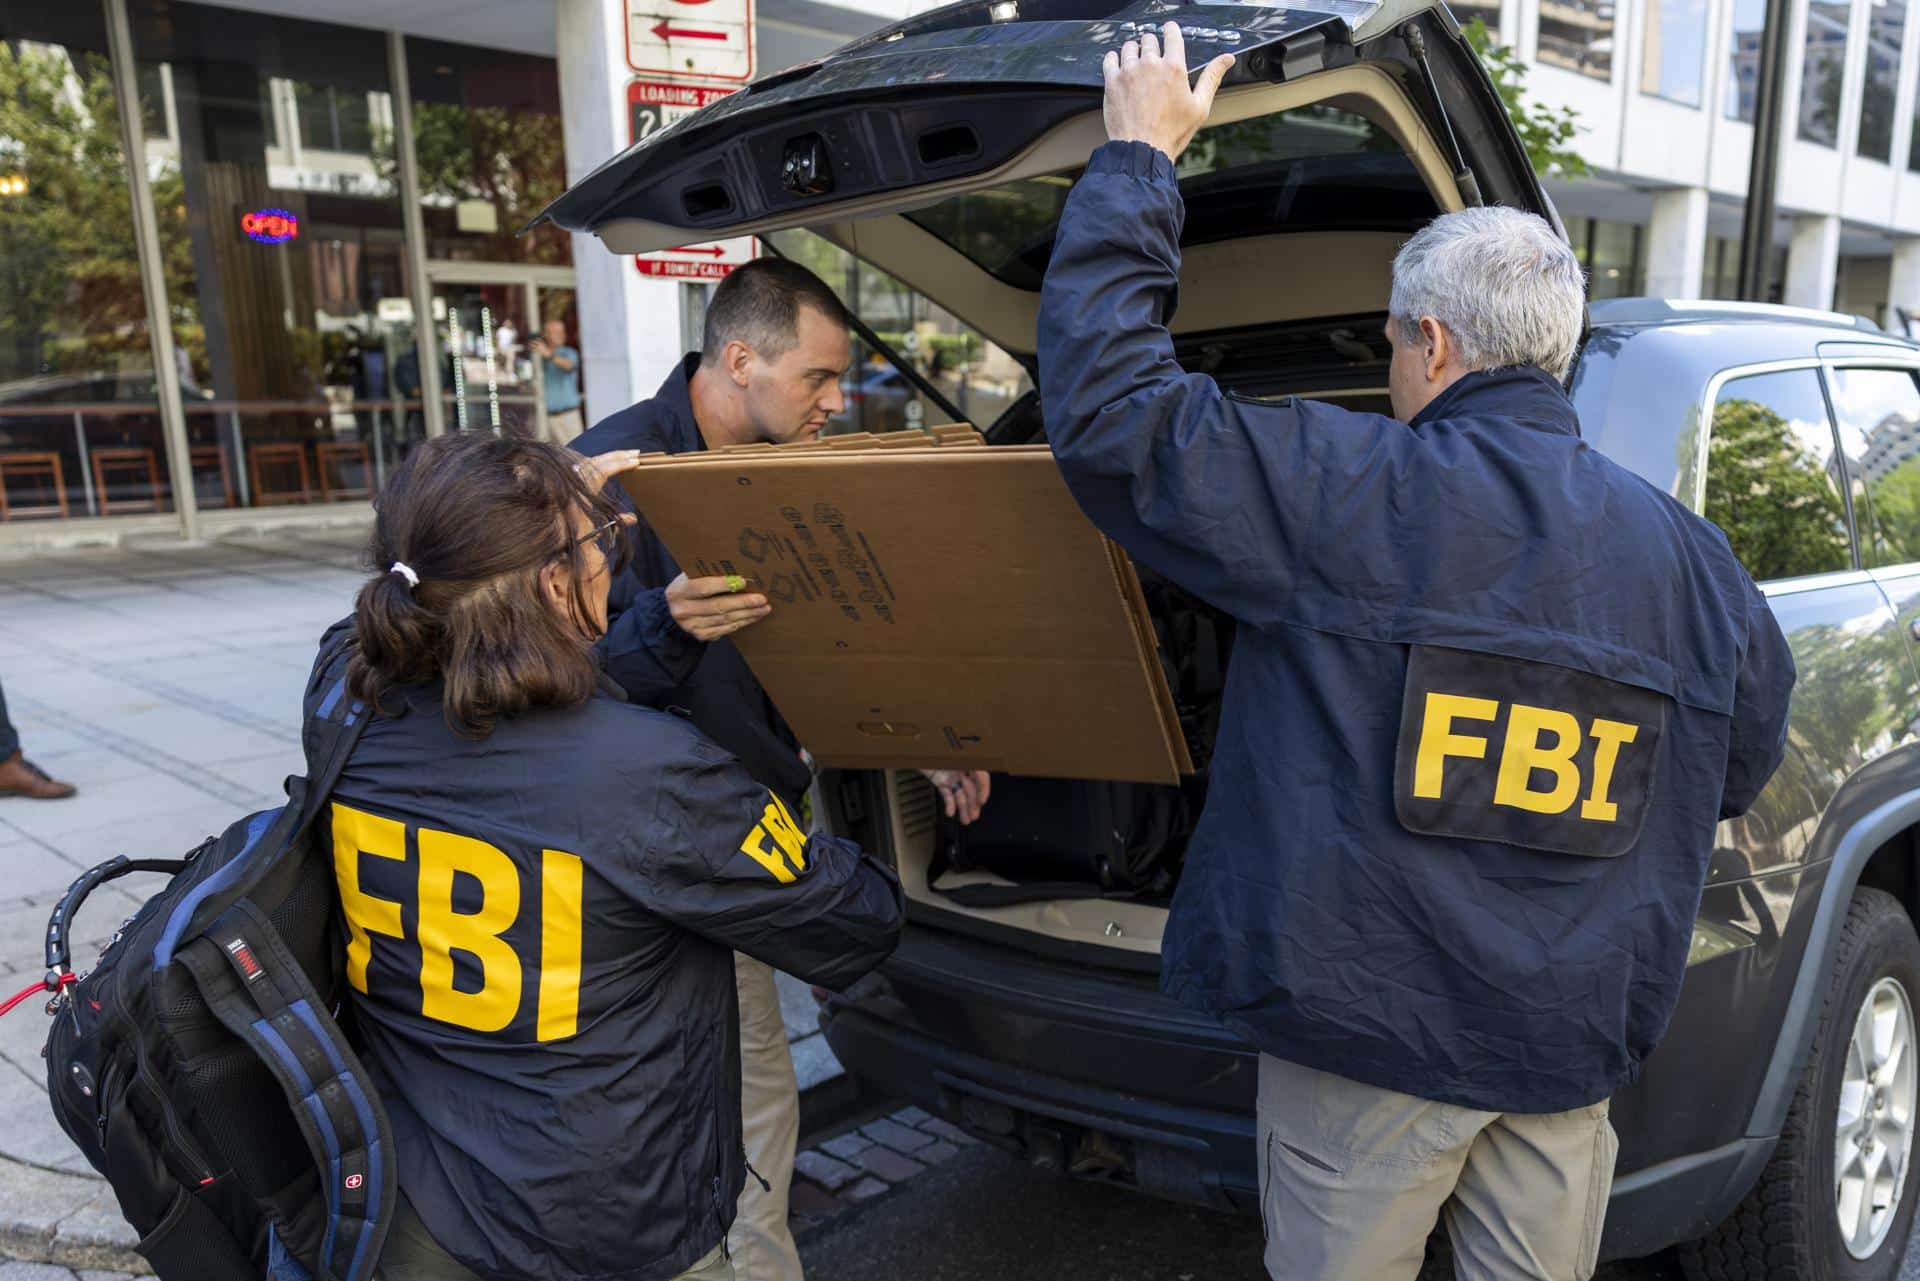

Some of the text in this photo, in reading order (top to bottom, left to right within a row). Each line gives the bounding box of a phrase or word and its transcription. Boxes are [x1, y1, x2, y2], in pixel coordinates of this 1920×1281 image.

[640, 85, 698, 104] LOADING
[639, 110, 656, 139] 2
[241, 212, 298, 239] OPEN
[701, 264, 724, 276] CALL
[1413, 692, 1639, 822] FBI
[740, 788, 808, 884] FBI
[331, 802, 583, 1042] FBI
